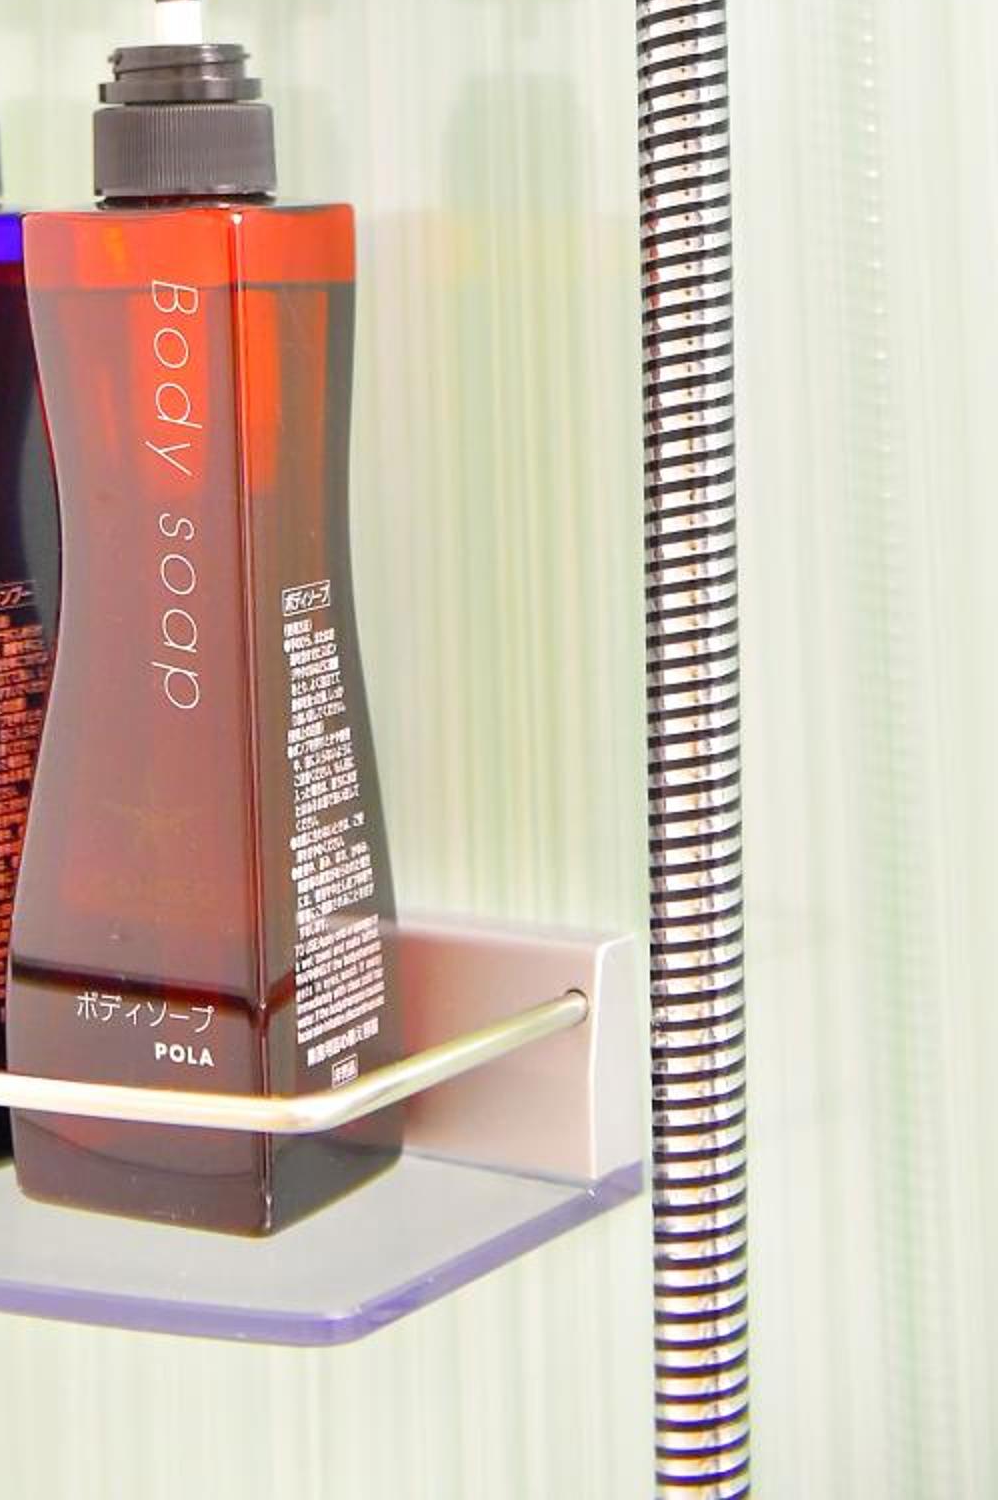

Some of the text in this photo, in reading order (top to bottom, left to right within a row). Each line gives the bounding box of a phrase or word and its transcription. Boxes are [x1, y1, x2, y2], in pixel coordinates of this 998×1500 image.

[146, 280, 202, 710] Body soap
[76, 991, 215, 1033] ボディソープ
[154, 1041, 215, 1067] POLA
